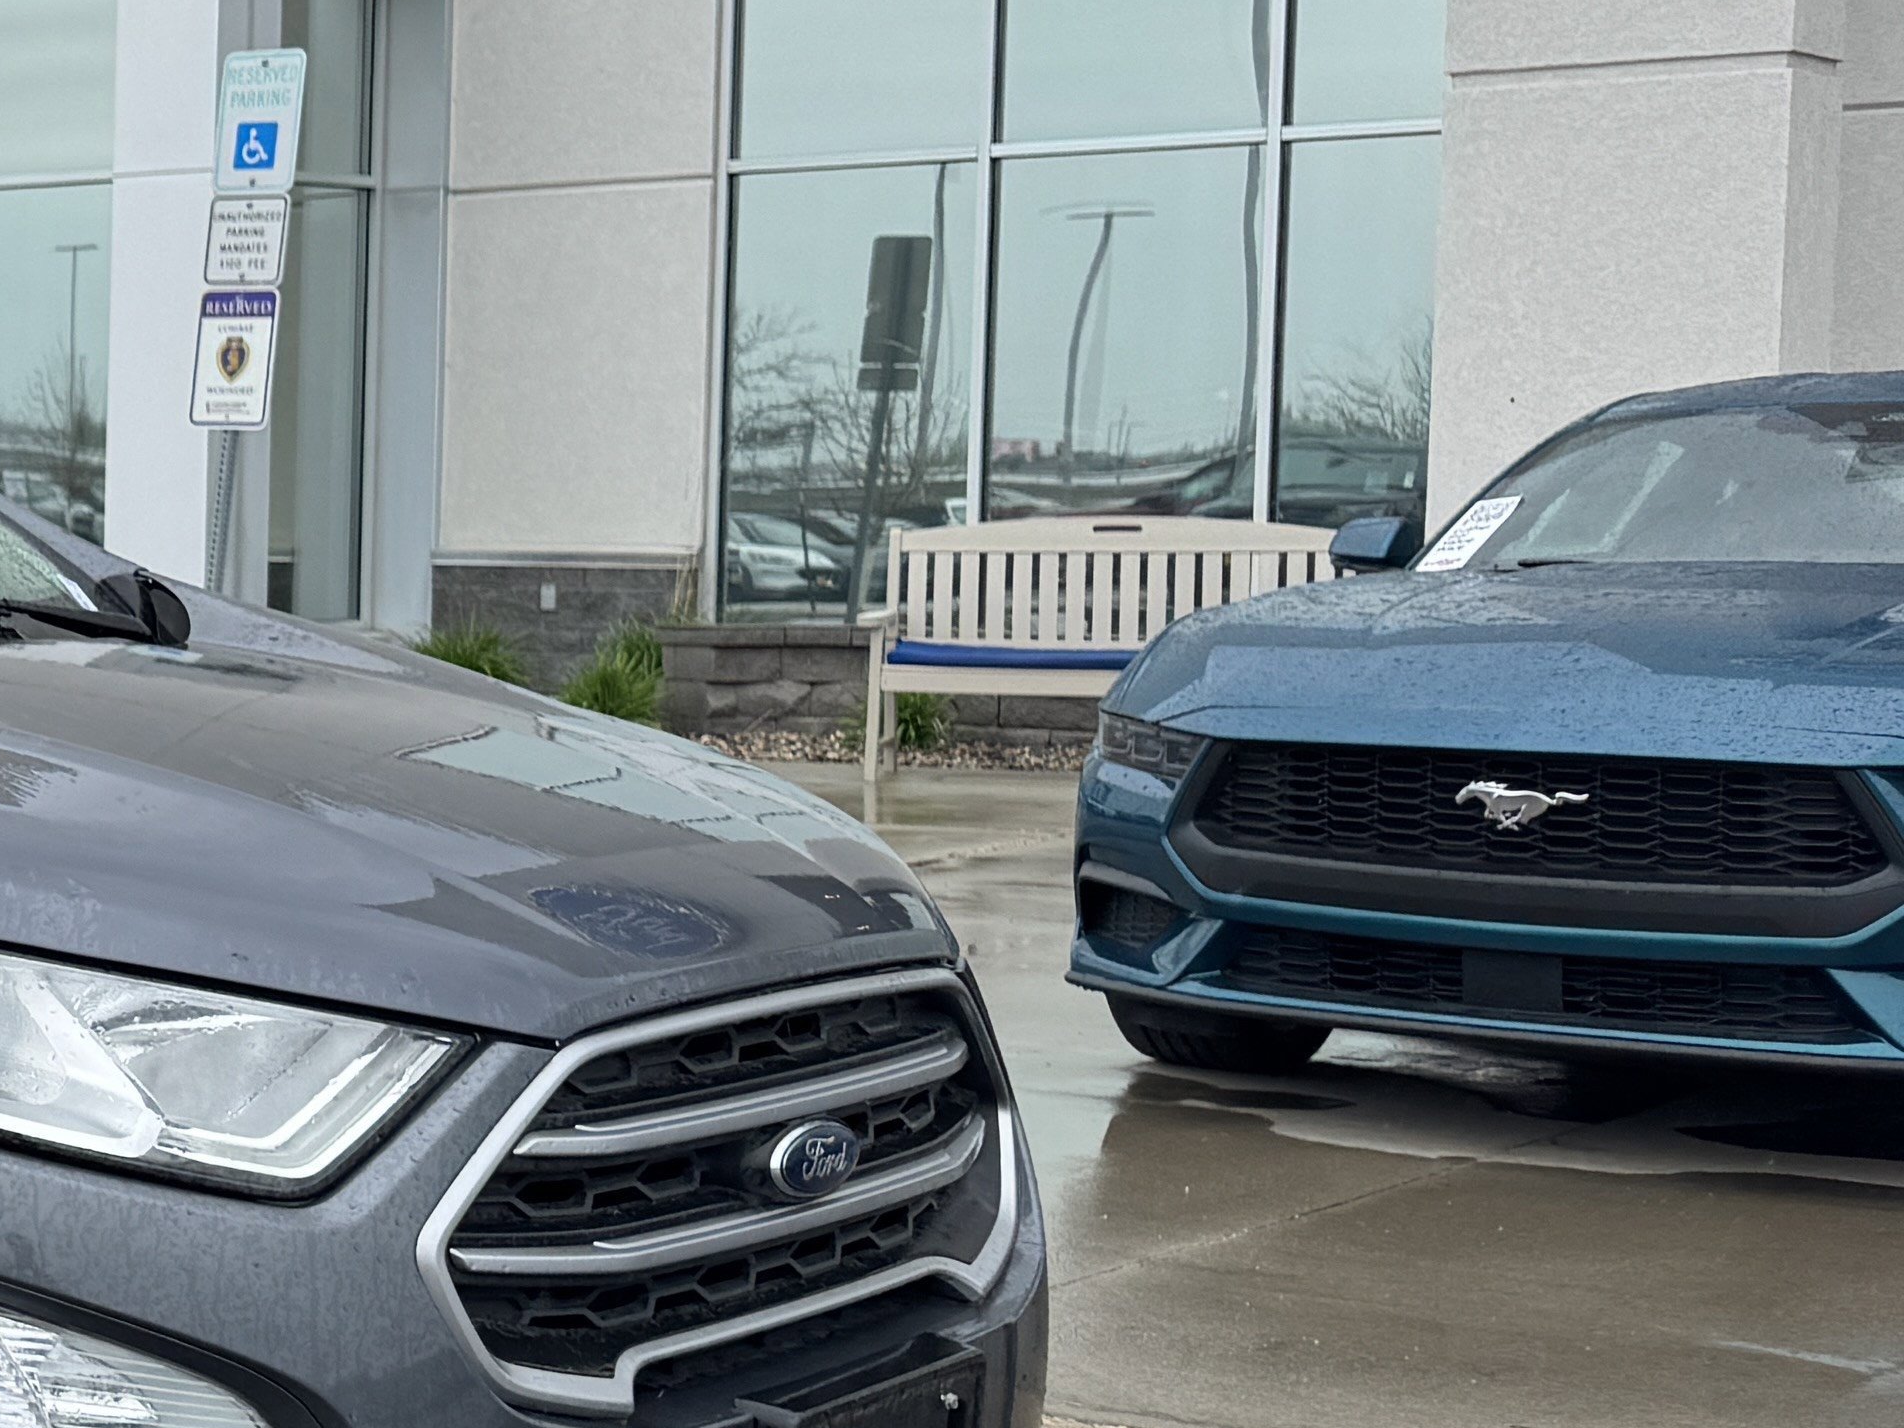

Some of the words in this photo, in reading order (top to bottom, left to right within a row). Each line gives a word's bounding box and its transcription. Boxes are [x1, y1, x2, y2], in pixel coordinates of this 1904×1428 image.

[228, 64, 298, 85] RESERVED
[231, 89, 292, 109] PARKING
[205, 299, 273, 315] RESERVED
[802, 1135, 848, 1181] Ford
